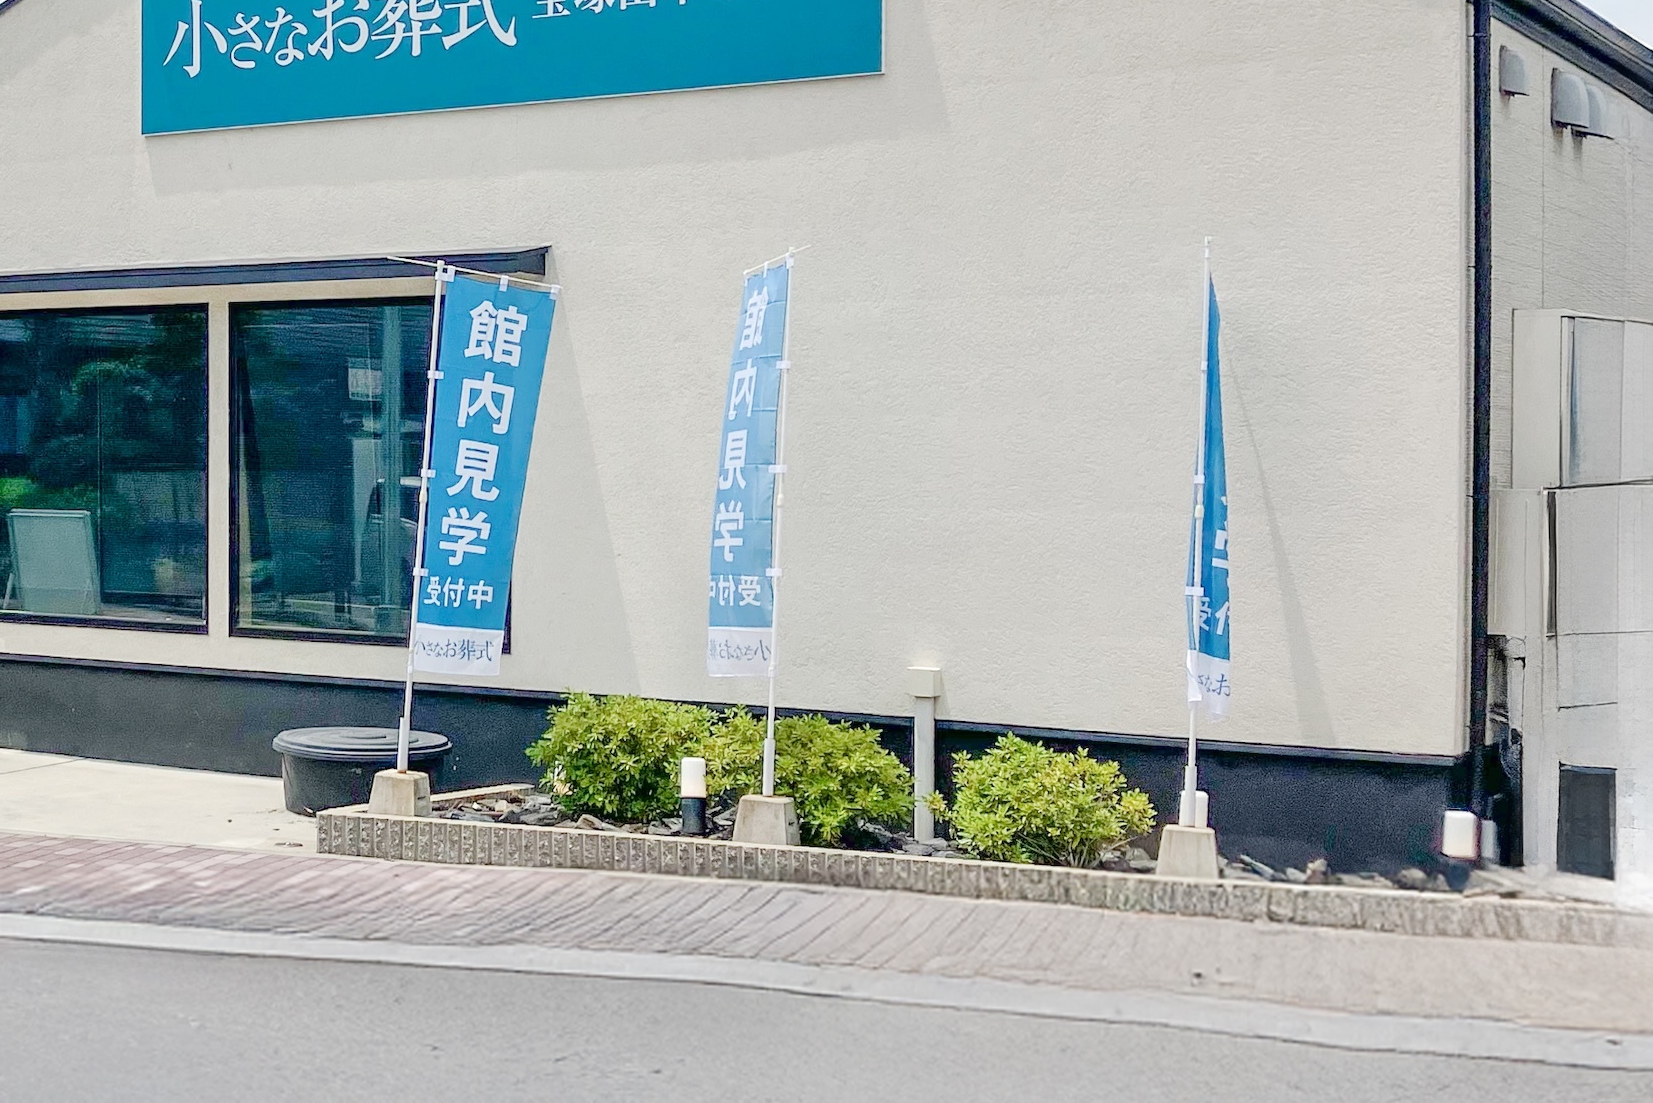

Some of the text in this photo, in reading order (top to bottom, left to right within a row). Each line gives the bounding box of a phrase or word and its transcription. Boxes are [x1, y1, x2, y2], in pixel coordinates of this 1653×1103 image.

[439, 299, 529, 567] 館内見学
[423, 575, 494, 611] 受付中
